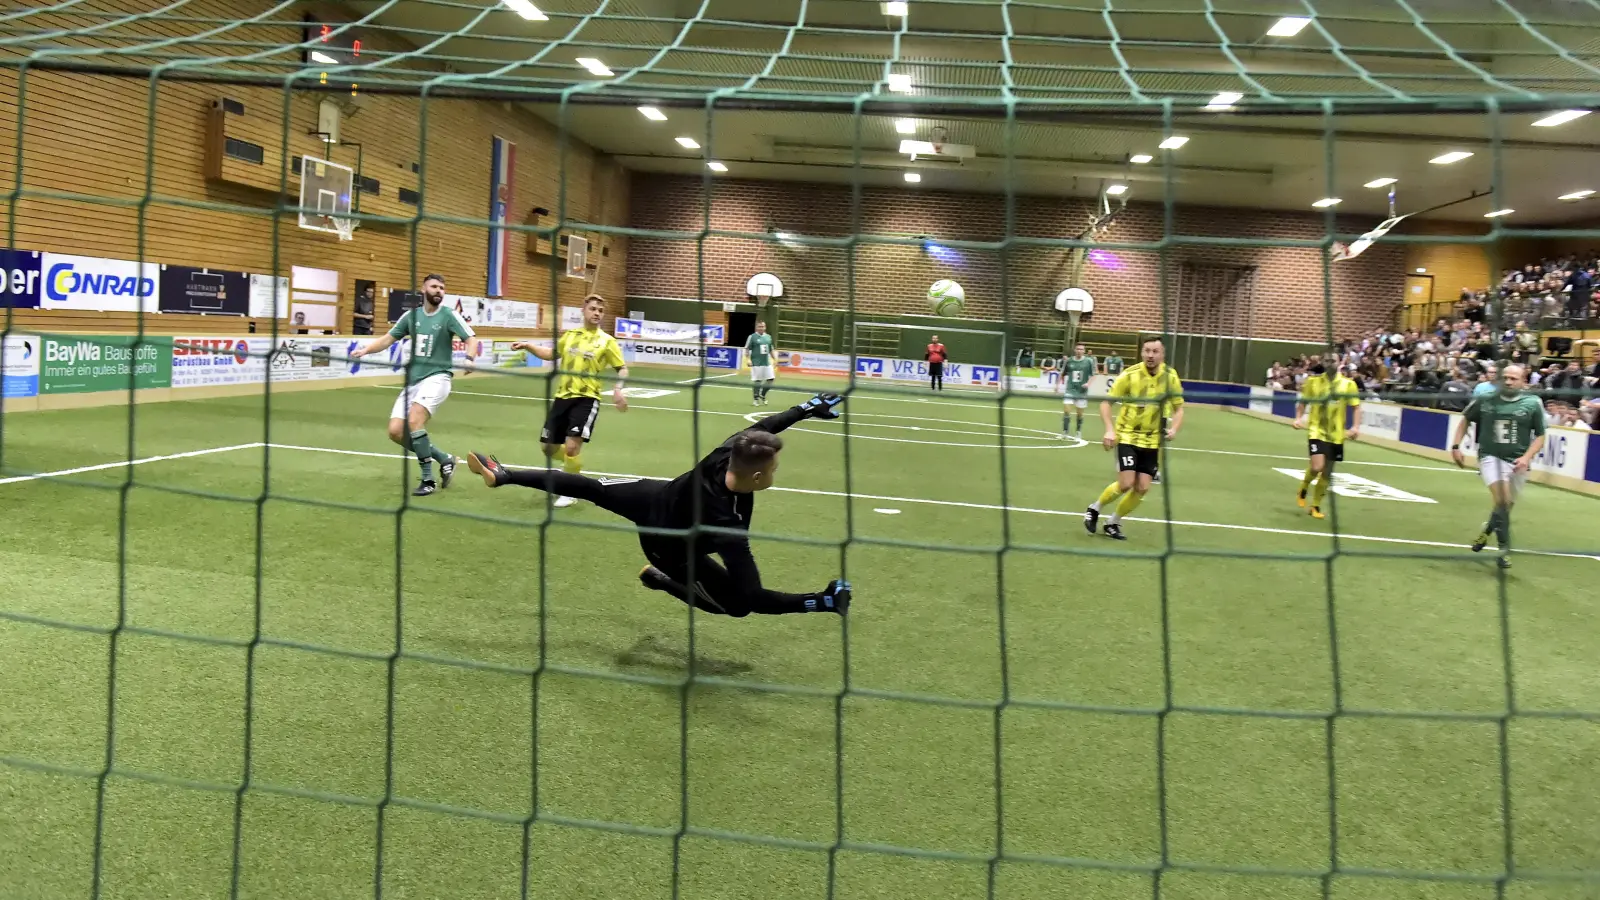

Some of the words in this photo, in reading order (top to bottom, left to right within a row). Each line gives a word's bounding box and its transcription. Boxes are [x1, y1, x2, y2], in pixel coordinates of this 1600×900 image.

[45, 340, 101, 366] BayWa
[173, 339, 234, 355] SEITZ
[635, 344, 706, 358] SCHMINKE
[45, 365, 75, 376] Immer
[78, 364, 91, 375] ein
[92, 364, 117, 377] gutes
[892, 360, 913, 374] VR
[917, 362, 961, 377] BNK
[1122, 456, 1134, 467] 15
